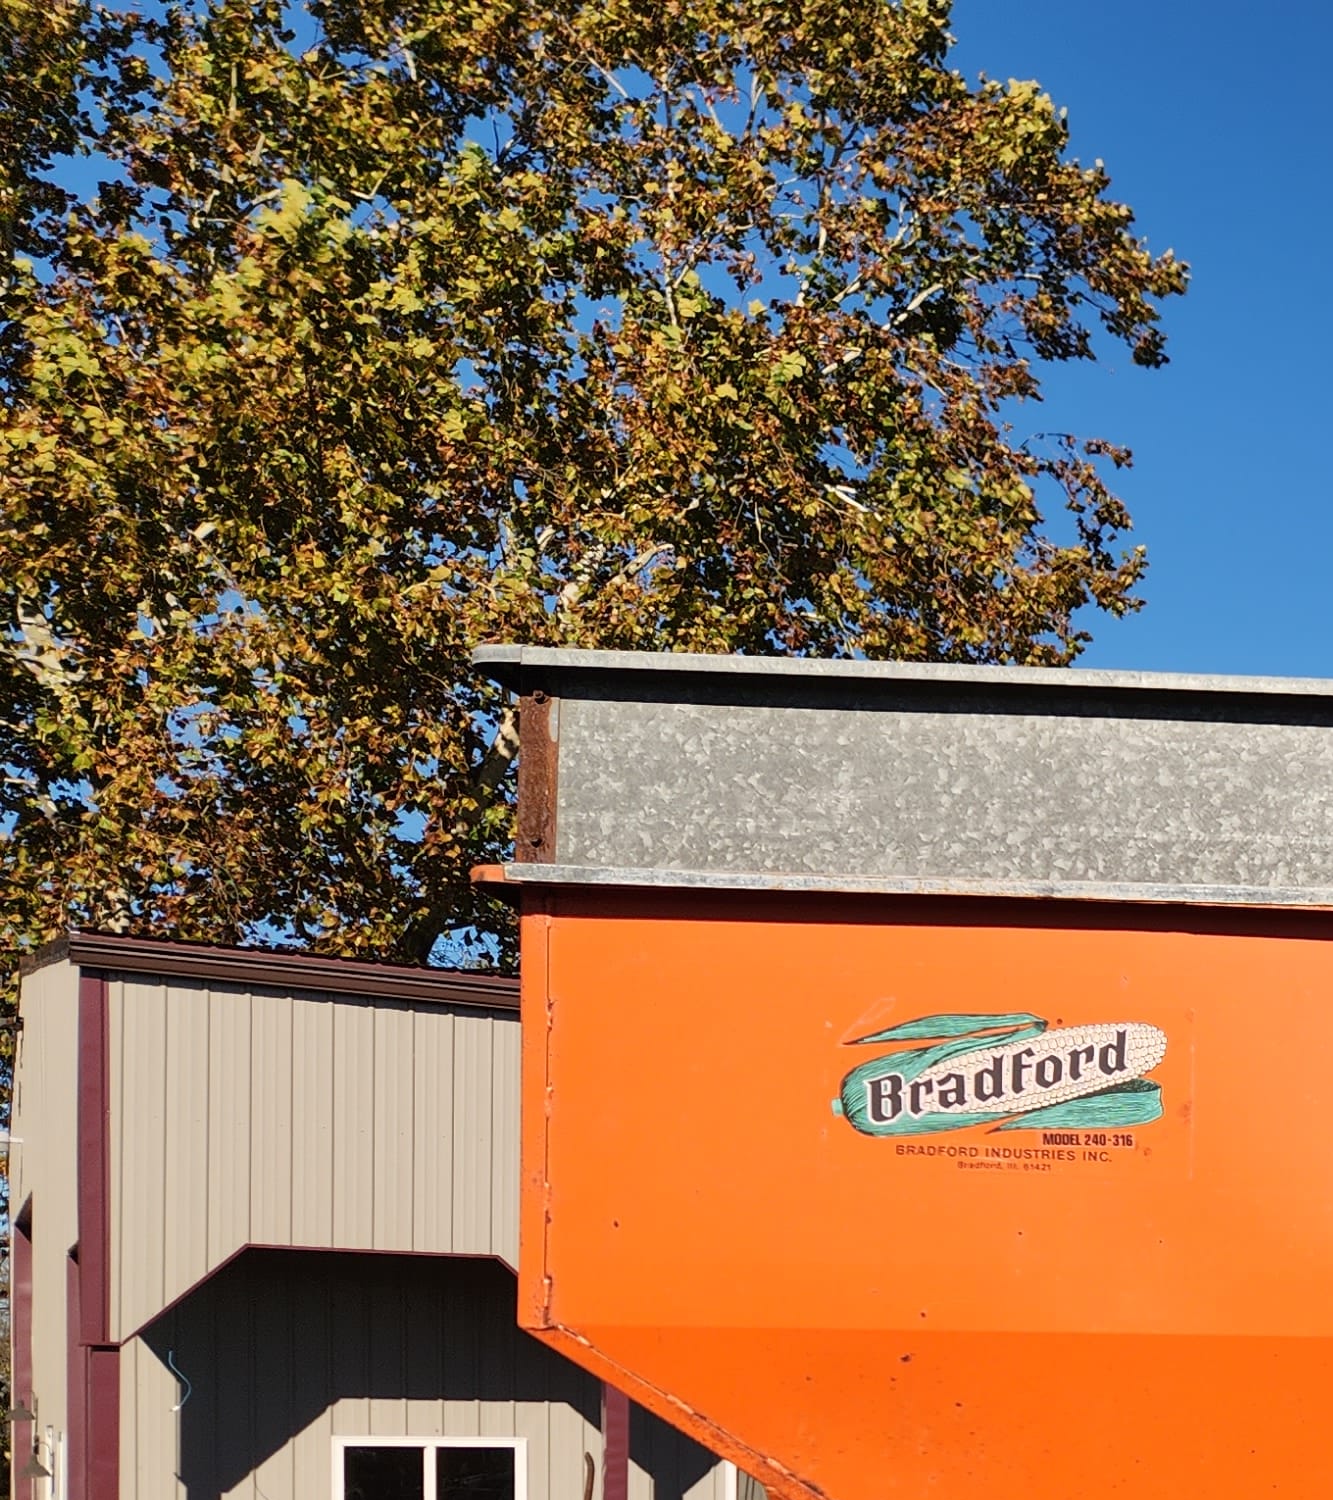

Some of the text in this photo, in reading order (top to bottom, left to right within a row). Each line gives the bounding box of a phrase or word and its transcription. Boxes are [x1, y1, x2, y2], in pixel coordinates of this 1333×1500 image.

[867, 1030, 1128, 1123] Bradford
[1043, 1133, 1133, 1147] MODEL 240-316
[895, 1145, 1113, 1163] BRADFORD INDUSTRIES INC.
